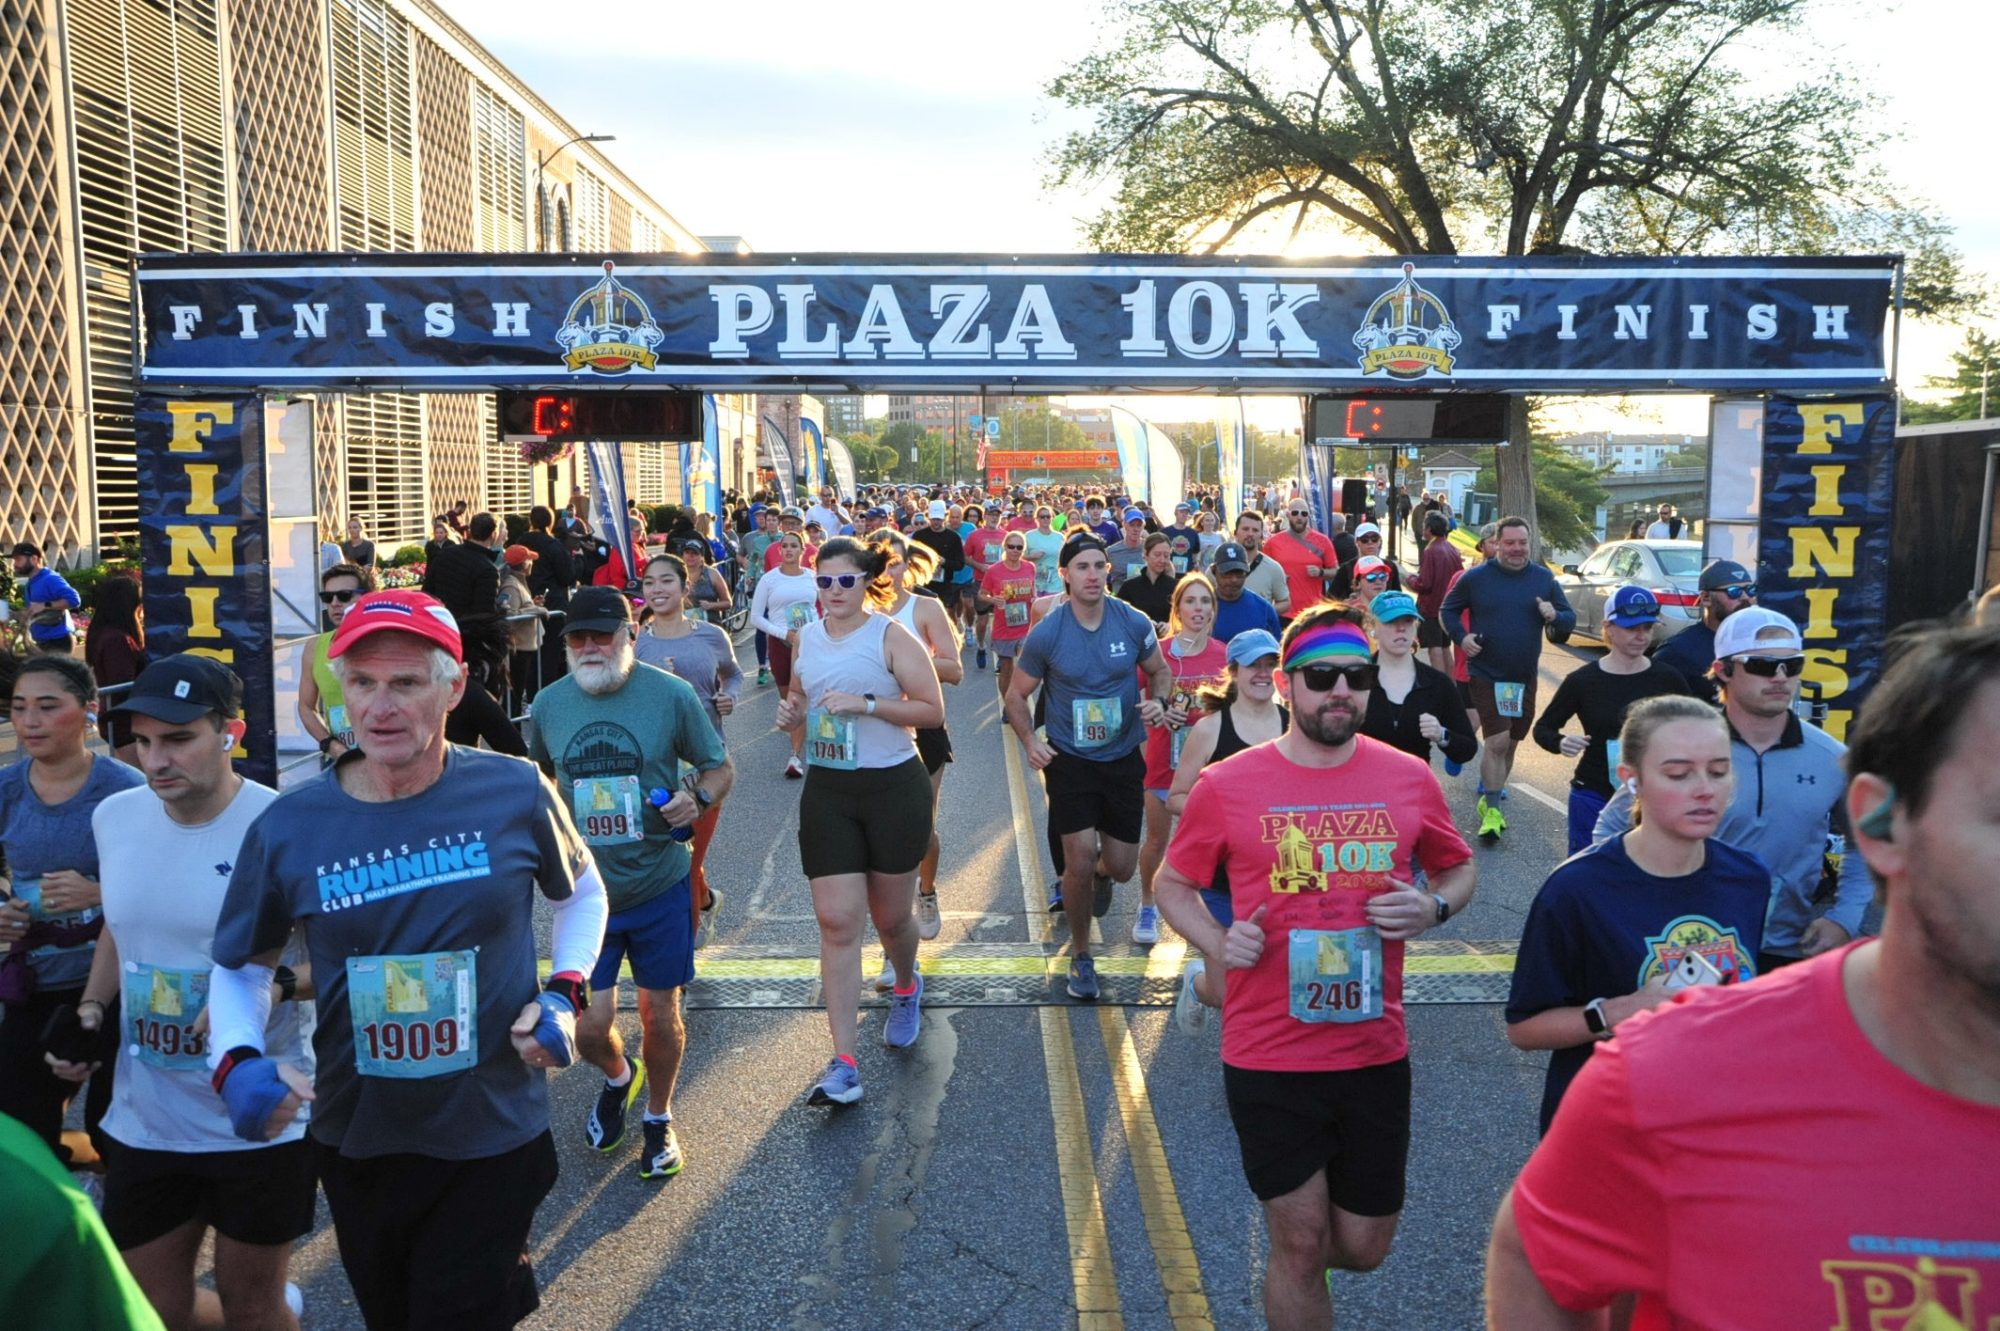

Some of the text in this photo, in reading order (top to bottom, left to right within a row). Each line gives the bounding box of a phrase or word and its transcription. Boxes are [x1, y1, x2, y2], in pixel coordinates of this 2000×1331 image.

[169, 302, 530, 340] FINISH
[709, 279, 1321, 360] PLAZA 10K
[1487, 304, 1849, 341] FINISH
[578, 347, 640, 360] PLAZA 10K
[1375, 349, 1438, 362] PLAZA 10K
[165, 401, 248, 758] FINI
[1087, 725, 1106, 740] 93
[814, 740, 845, 760] 1741
[587, 813, 628, 837] 999
[1260, 809, 1399, 843] PLAZA
[316, 831, 482, 877] KANSAS CITY
[1317, 841, 1397, 872] 10K
[318, 842, 490, 901] RUNNING
[388, 879, 432, 894] MARATHON
[434, 872, 470, 884] TRAINING
[321, 893, 364, 913] CLUB
[1306, 981, 1362, 1011] 246
[133, 1018, 204, 1057] 1493
[362, 1017, 459, 1062] 1909
